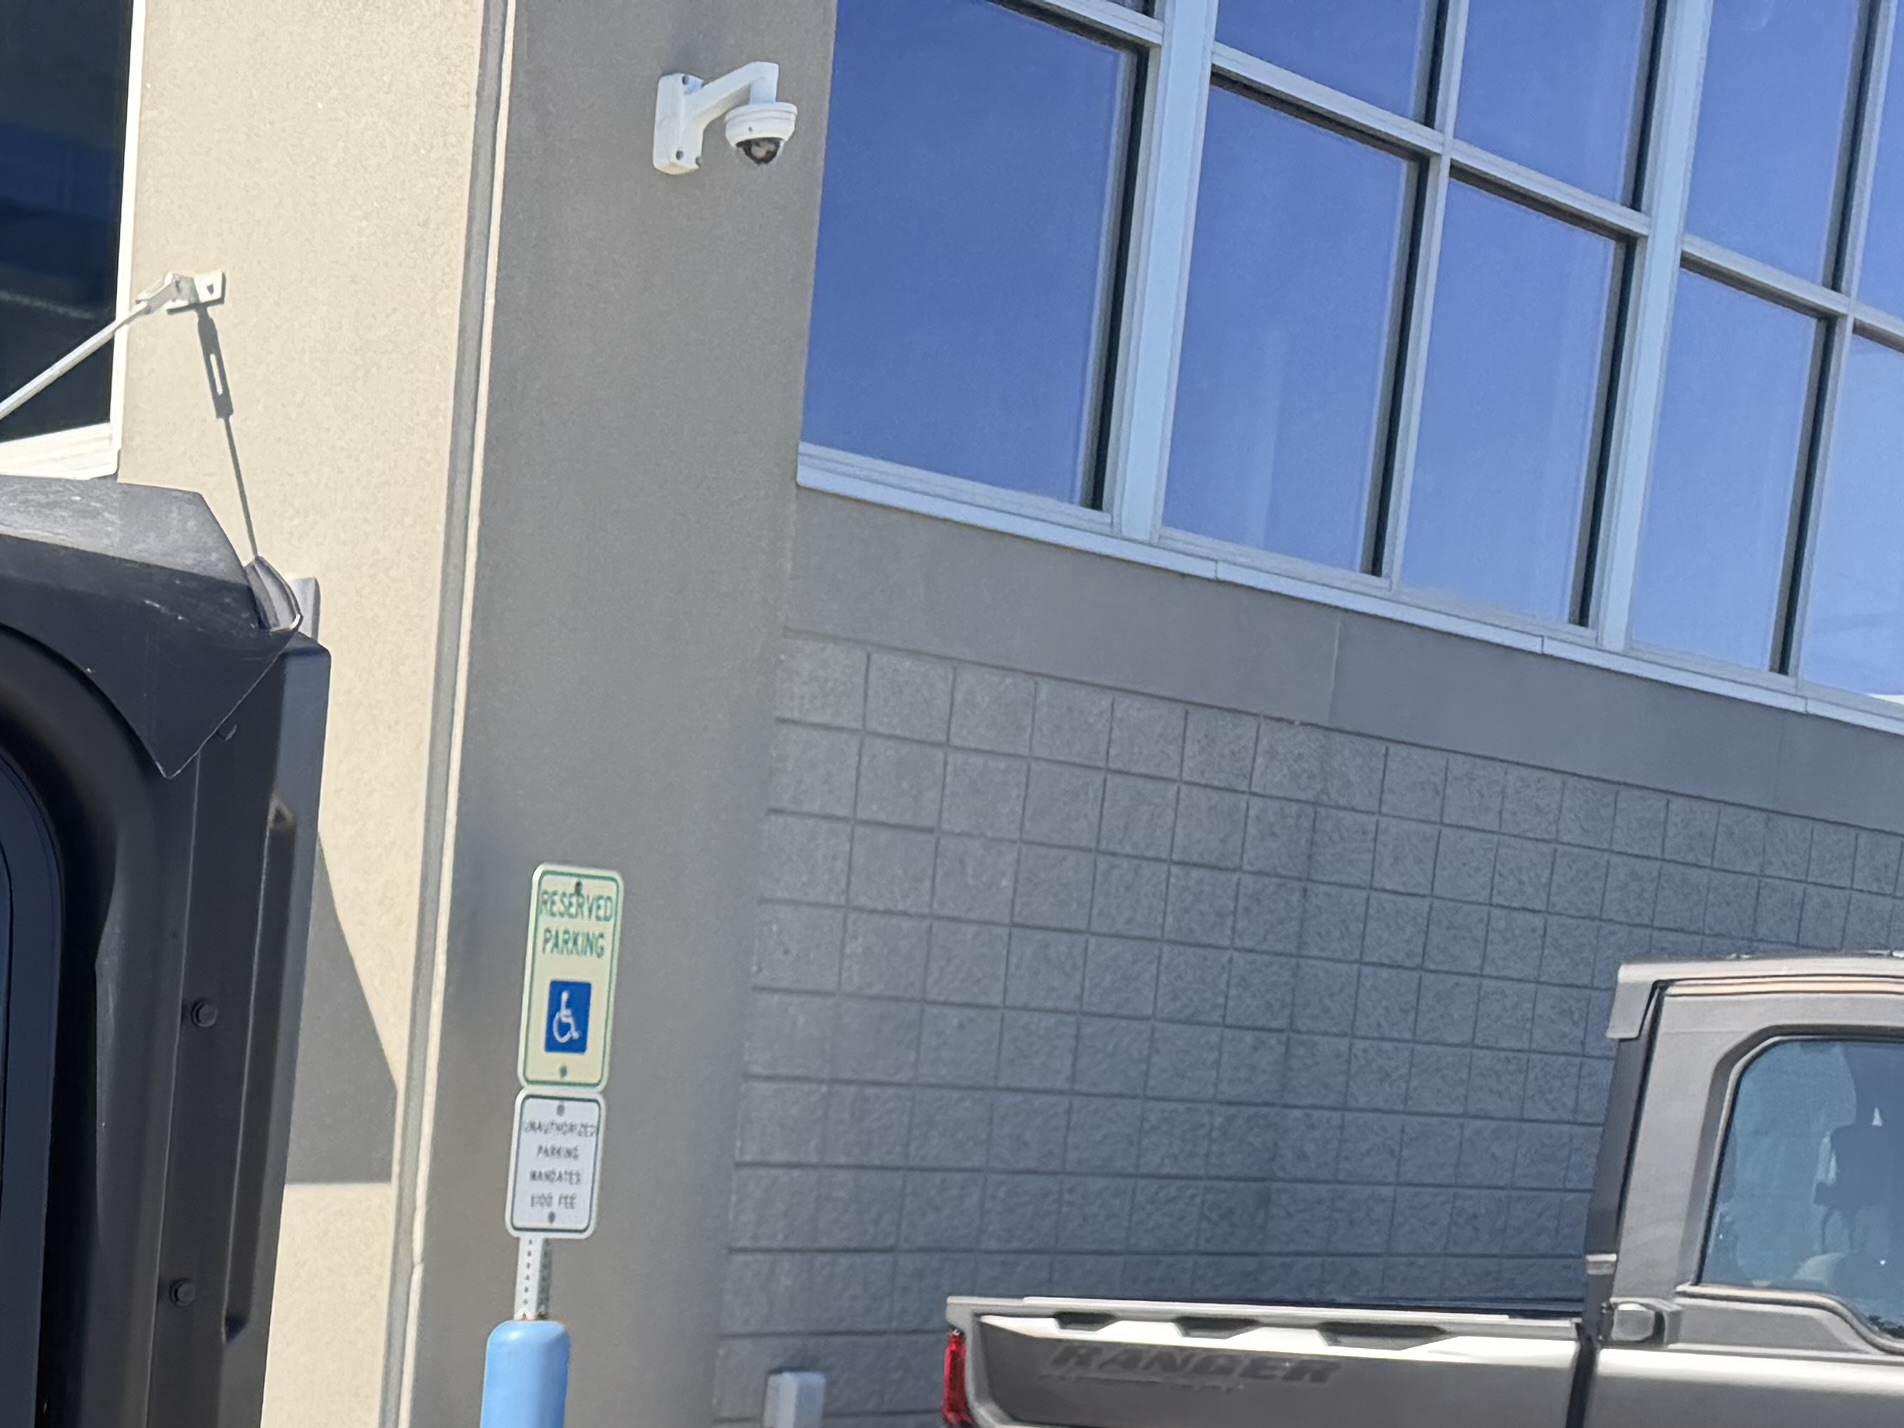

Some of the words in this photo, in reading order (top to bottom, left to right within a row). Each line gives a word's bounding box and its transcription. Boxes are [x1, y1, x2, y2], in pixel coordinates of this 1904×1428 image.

[539, 890, 613, 922] RESERVED
[542, 927, 605, 959] PARKING
[536, 1144, 580, 1160] PARKING
[1049, 1346, 1342, 1384] RANGER
